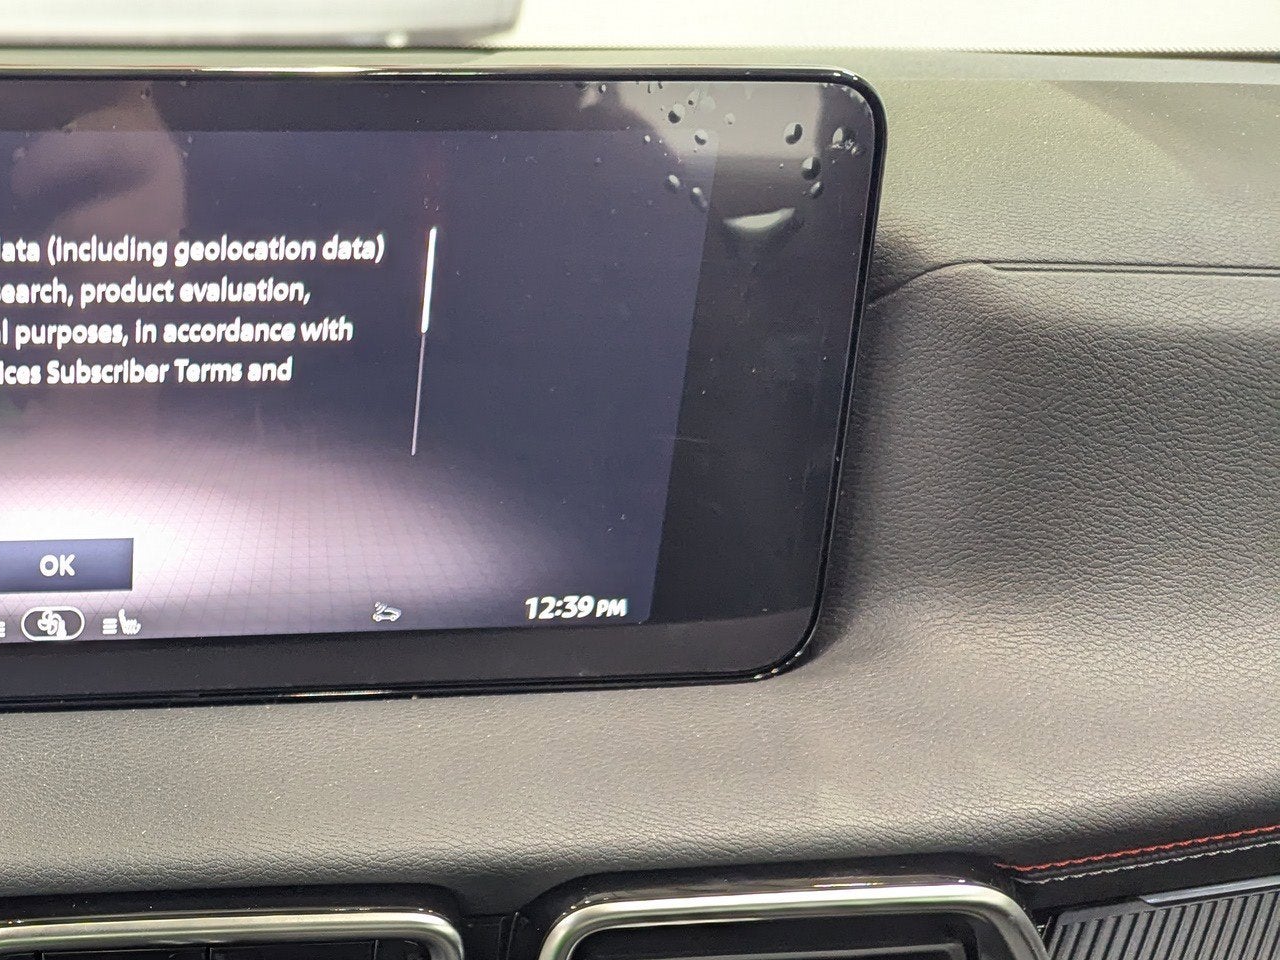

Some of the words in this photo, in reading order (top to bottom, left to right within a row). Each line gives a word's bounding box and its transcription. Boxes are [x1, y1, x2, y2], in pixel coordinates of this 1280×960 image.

[47, 234, 168, 267] (including
[173, 234, 316, 267] geolocation
[322, 233, 385, 264] data)
[80, 276, 175, 309] product
[179, 275, 311, 305] evaluation,
[15, 322, 129, 350] purposes,
[135, 318, 157, 343] in
[163, 316, 296, 343] accordance
[300, 315, 354, 342] with
[46, 358, 169, 384] Subscriber
[173, 358, 243, 384] Terms
[247, 356, 293, 382] and
[39, 554, 76, 577] OK
[525, 595, 595, 620] 12:39
[595, 598, 628, 618] PM
